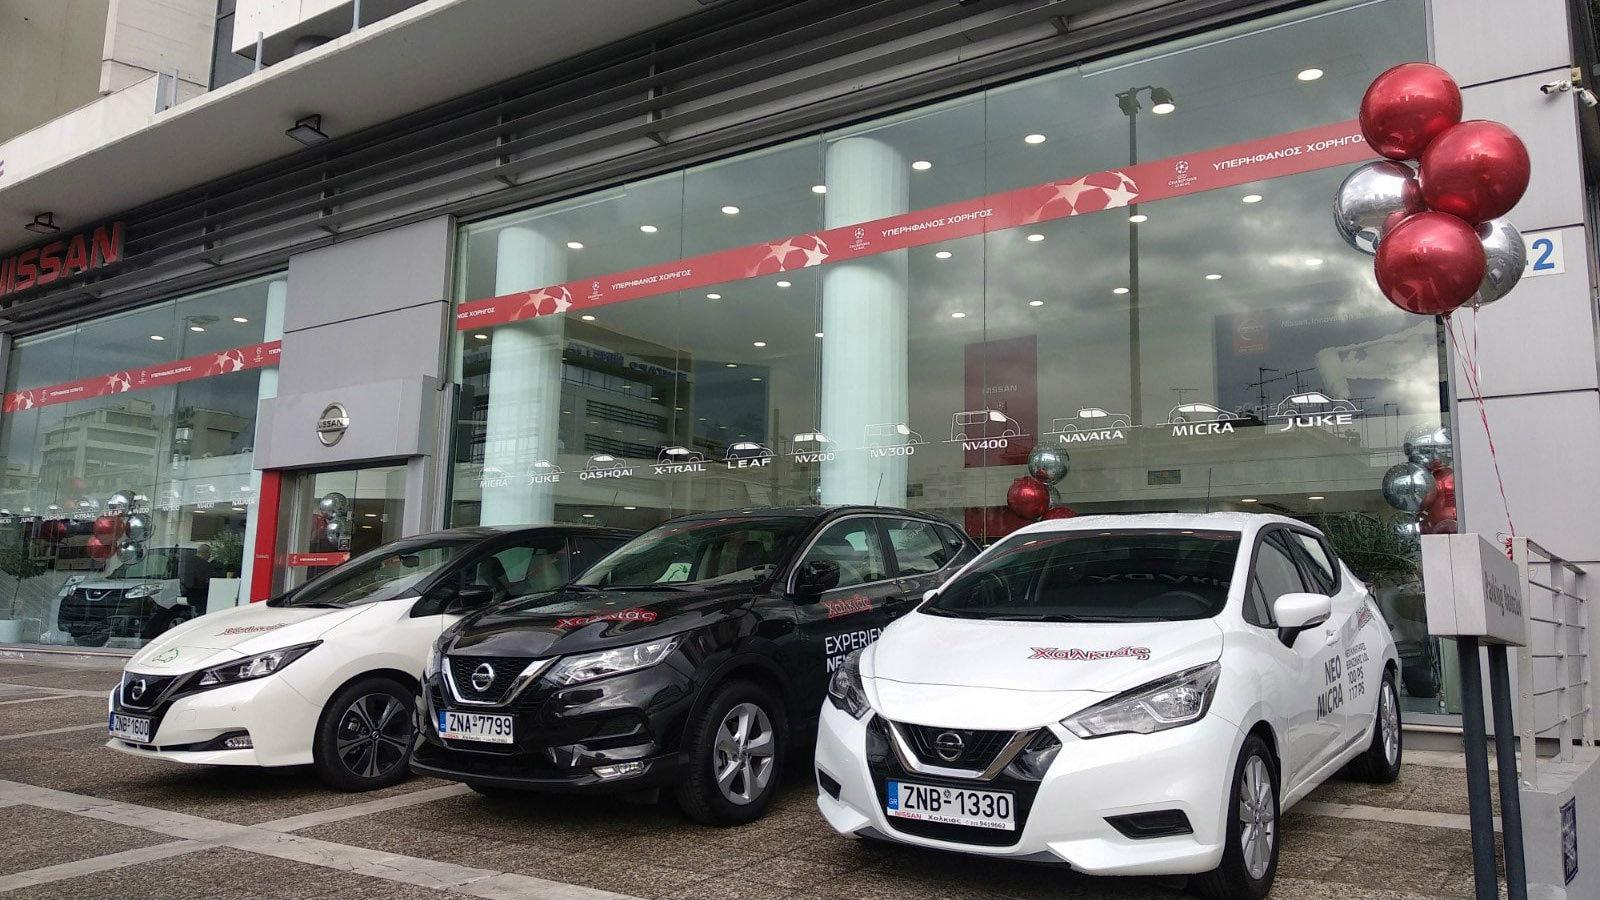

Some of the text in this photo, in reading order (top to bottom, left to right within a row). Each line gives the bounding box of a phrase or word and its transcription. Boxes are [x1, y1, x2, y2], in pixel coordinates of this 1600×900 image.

[1212, 146, 1303, 171] ΥΠΕΡΗΦΑΝΟΣ
[881, 208, 993, 238] ΥΠΕΡΗΦΑΝΟΣ ΧΟΡΗΓΟΣ
[0, 221, 123, 297] ISSAN
[1172, 422, 1235, 437] MICRA
[1281, 414, 1353, 432] JUKE
[1059, 430, 1124, 444] NAVARA
[962, 438, 1008, 451] NV400
[795, 452, 835, 463] NV200
[870, 446, 915, 458] NV300
[654, 463, 706, 475] X-TRAIL
[727, 457, 772, 469] LEAF
[528, 474, 560, 486] JUKE
[579, 469, 633, 480] QASHQAI
[1316, 683, 1343, 721] MICRA
[450, 714, 512, 736] ZNA-7799
[904, 786, 1010, 819] ZNB-1330
[895, 811, 922, 819] NISSAN
